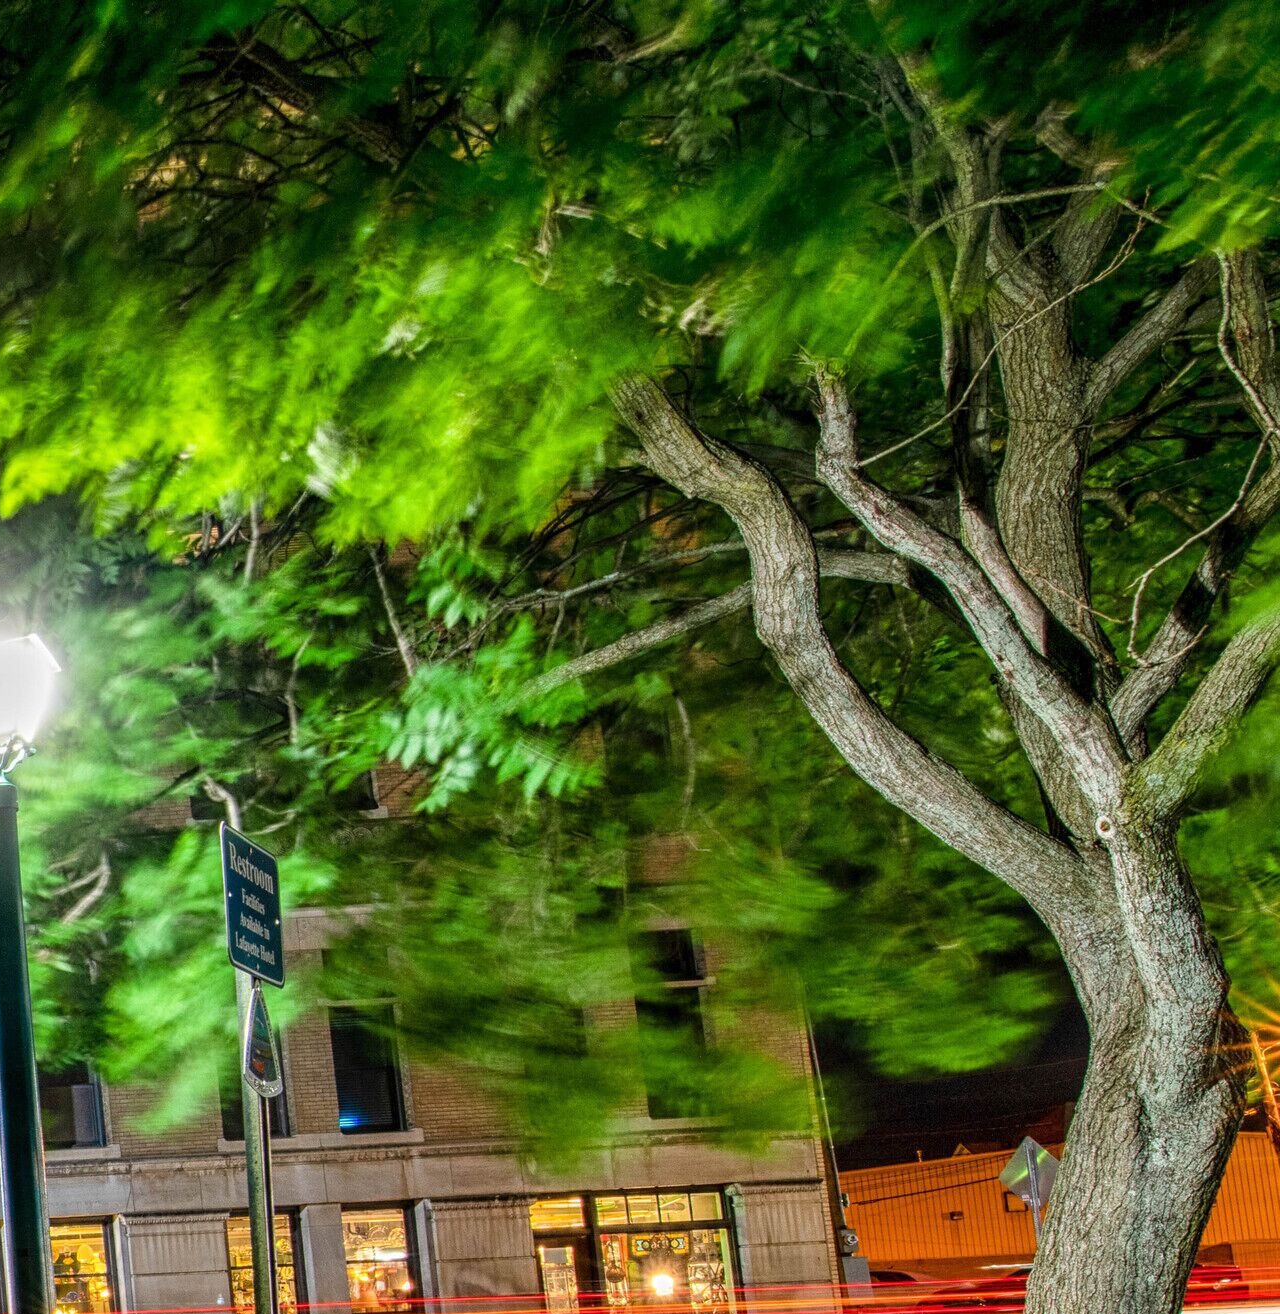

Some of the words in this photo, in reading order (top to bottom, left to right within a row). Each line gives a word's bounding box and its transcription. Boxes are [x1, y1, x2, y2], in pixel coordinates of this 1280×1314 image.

[228, 841, 274, 894] Restroom
[241, 887, 266, 916] Facilities
[240, 911, 264, 938] Available
[263, 924, 270, 940] in
[235, 931, 260, 958] Lafayette
[260, 944, 275, 966] Hotel
